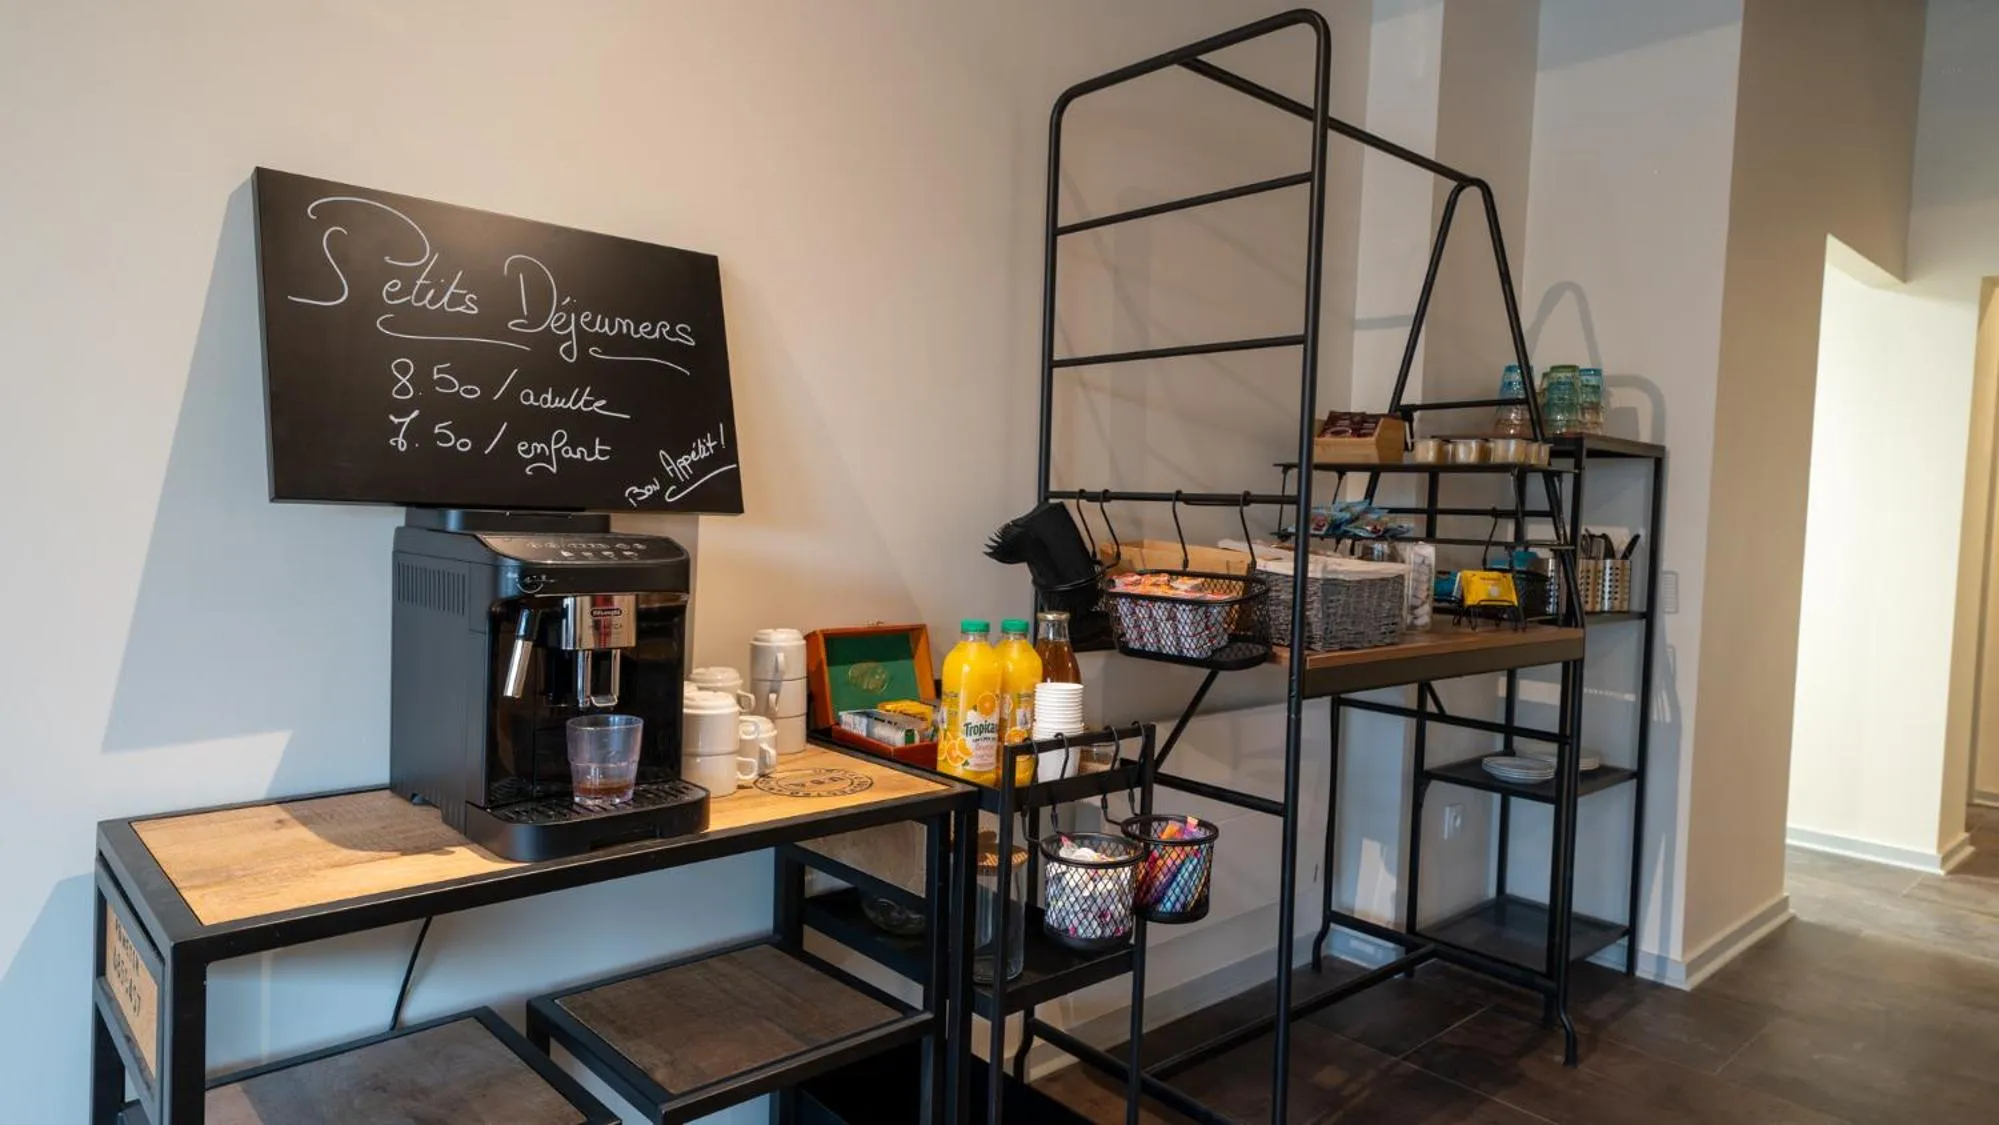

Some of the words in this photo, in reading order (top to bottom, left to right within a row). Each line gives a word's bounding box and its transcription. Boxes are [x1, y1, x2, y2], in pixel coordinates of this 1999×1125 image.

[288, 197, 479, 314] Petits
[504, 254, 696, 363] Déjeuners
[520, 386, 631, 418] adulte
[517, 429, 611, 474] enfant
